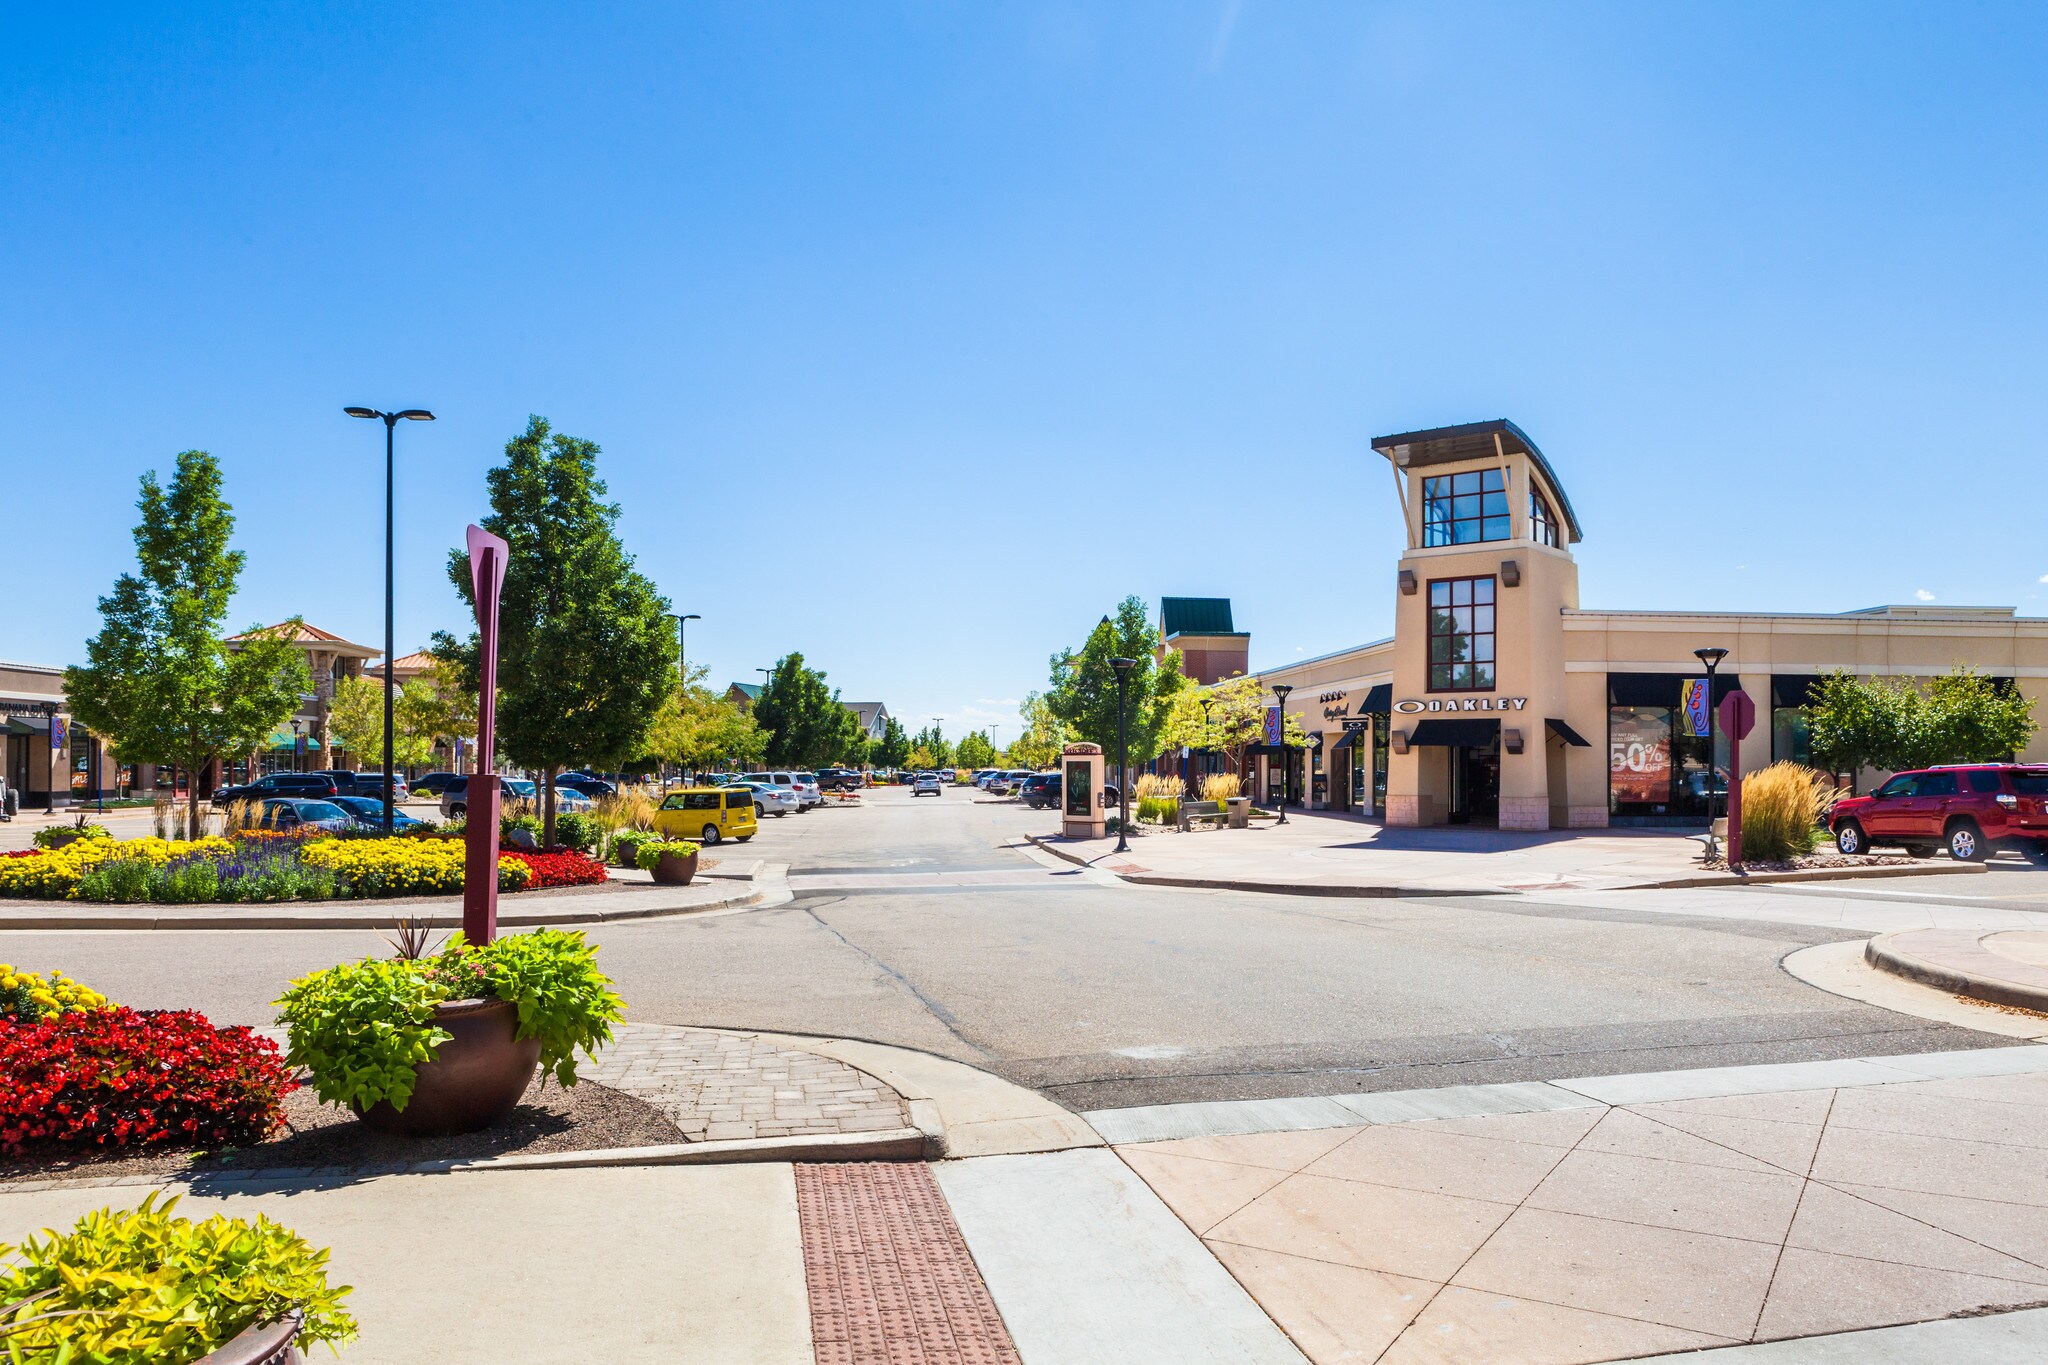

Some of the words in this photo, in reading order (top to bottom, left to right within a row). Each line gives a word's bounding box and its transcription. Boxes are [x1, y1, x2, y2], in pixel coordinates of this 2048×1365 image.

[1428, 698, 1527, 712] OAKLEY
[1611, 743, 1663, 772] 50%
[1645, 763, 1663, 771] OFF
